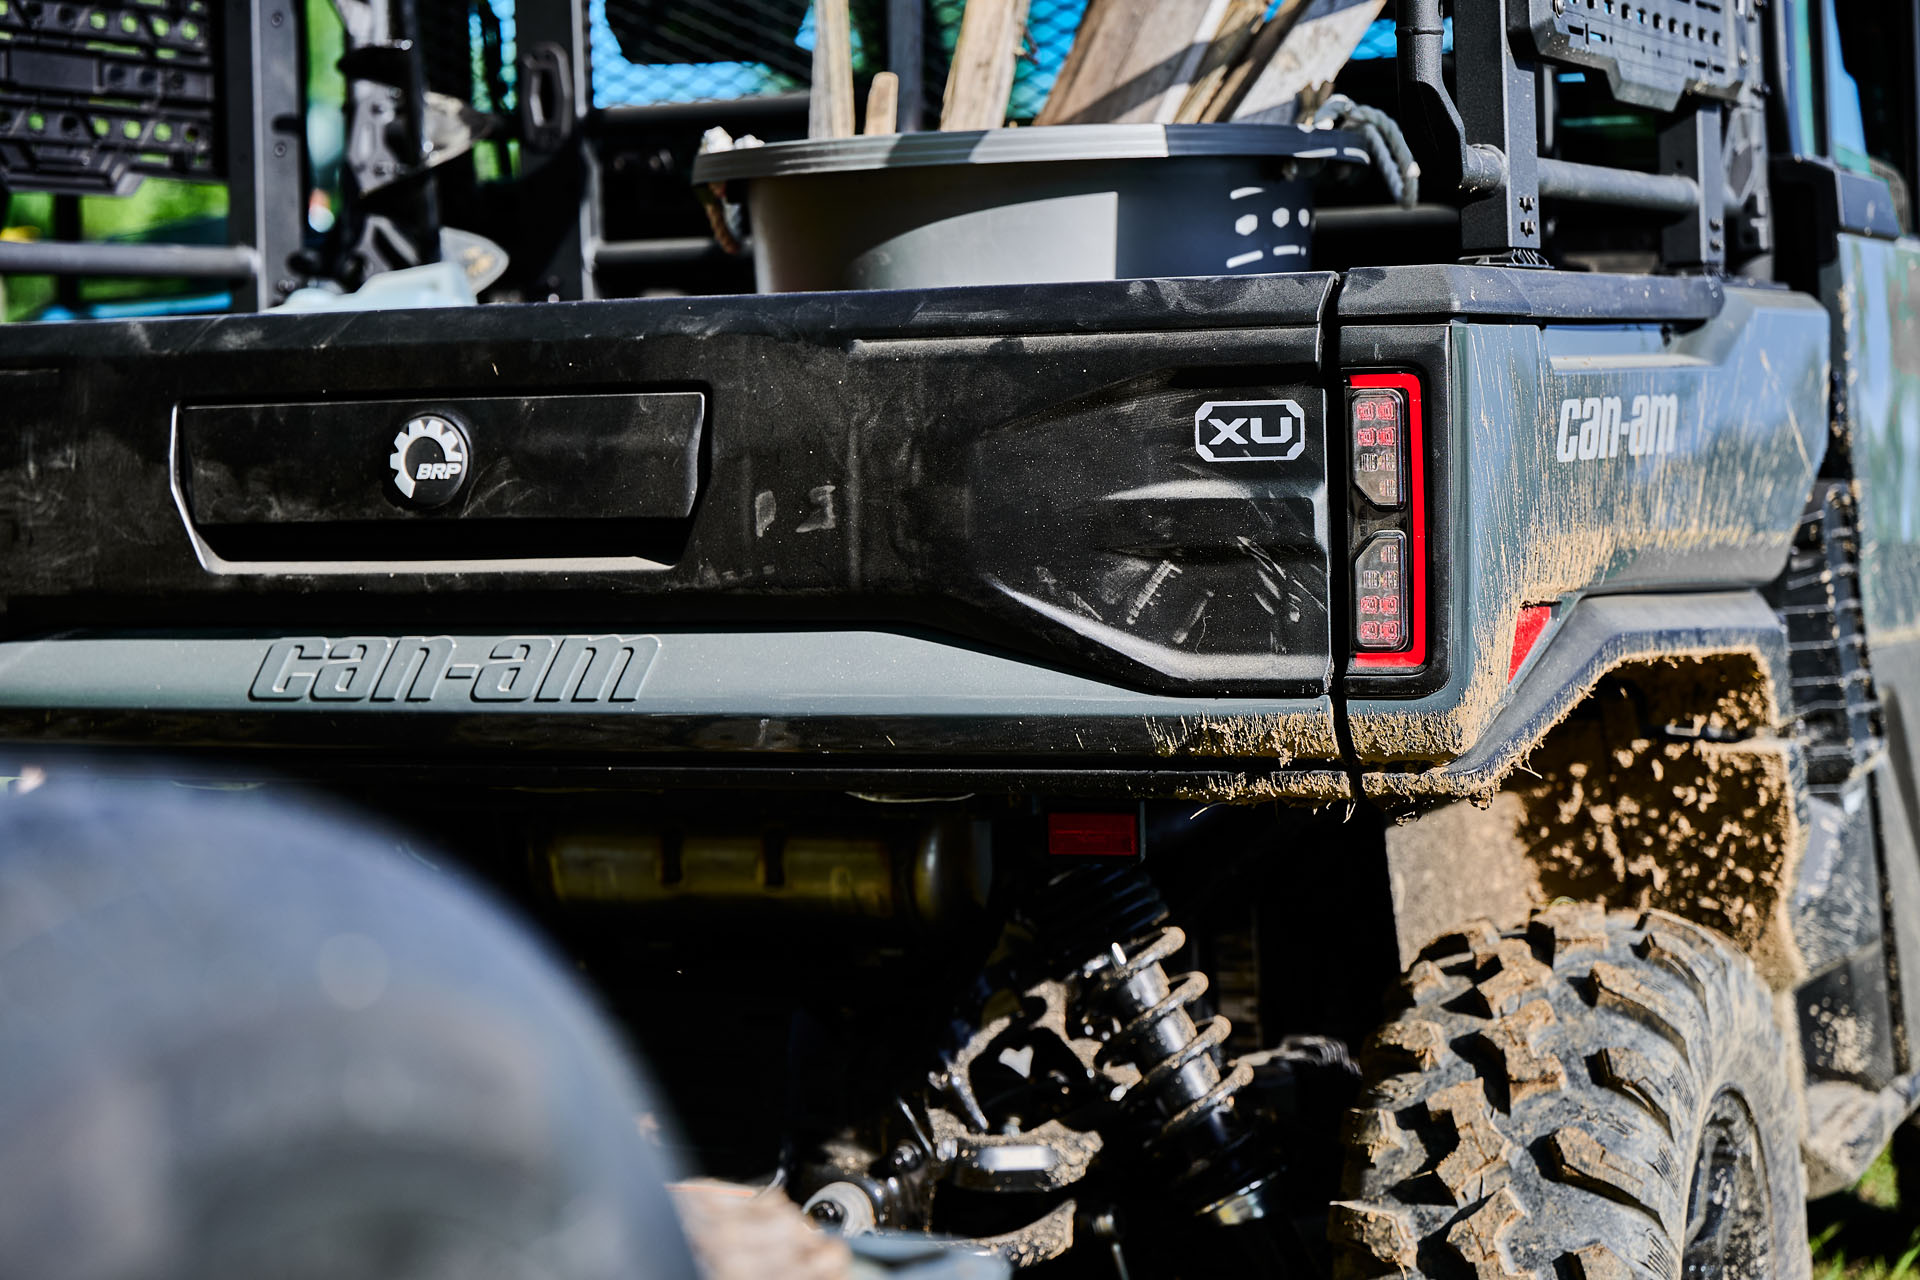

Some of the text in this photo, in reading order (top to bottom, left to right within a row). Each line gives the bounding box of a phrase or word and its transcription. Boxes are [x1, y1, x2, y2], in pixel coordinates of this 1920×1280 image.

[1207, 416, 1293, 446] XU
[1556, 394, 1678, 463] can-am
[415, 462, 462, 480] BRP
[248, 634, 662, 704] can-am
